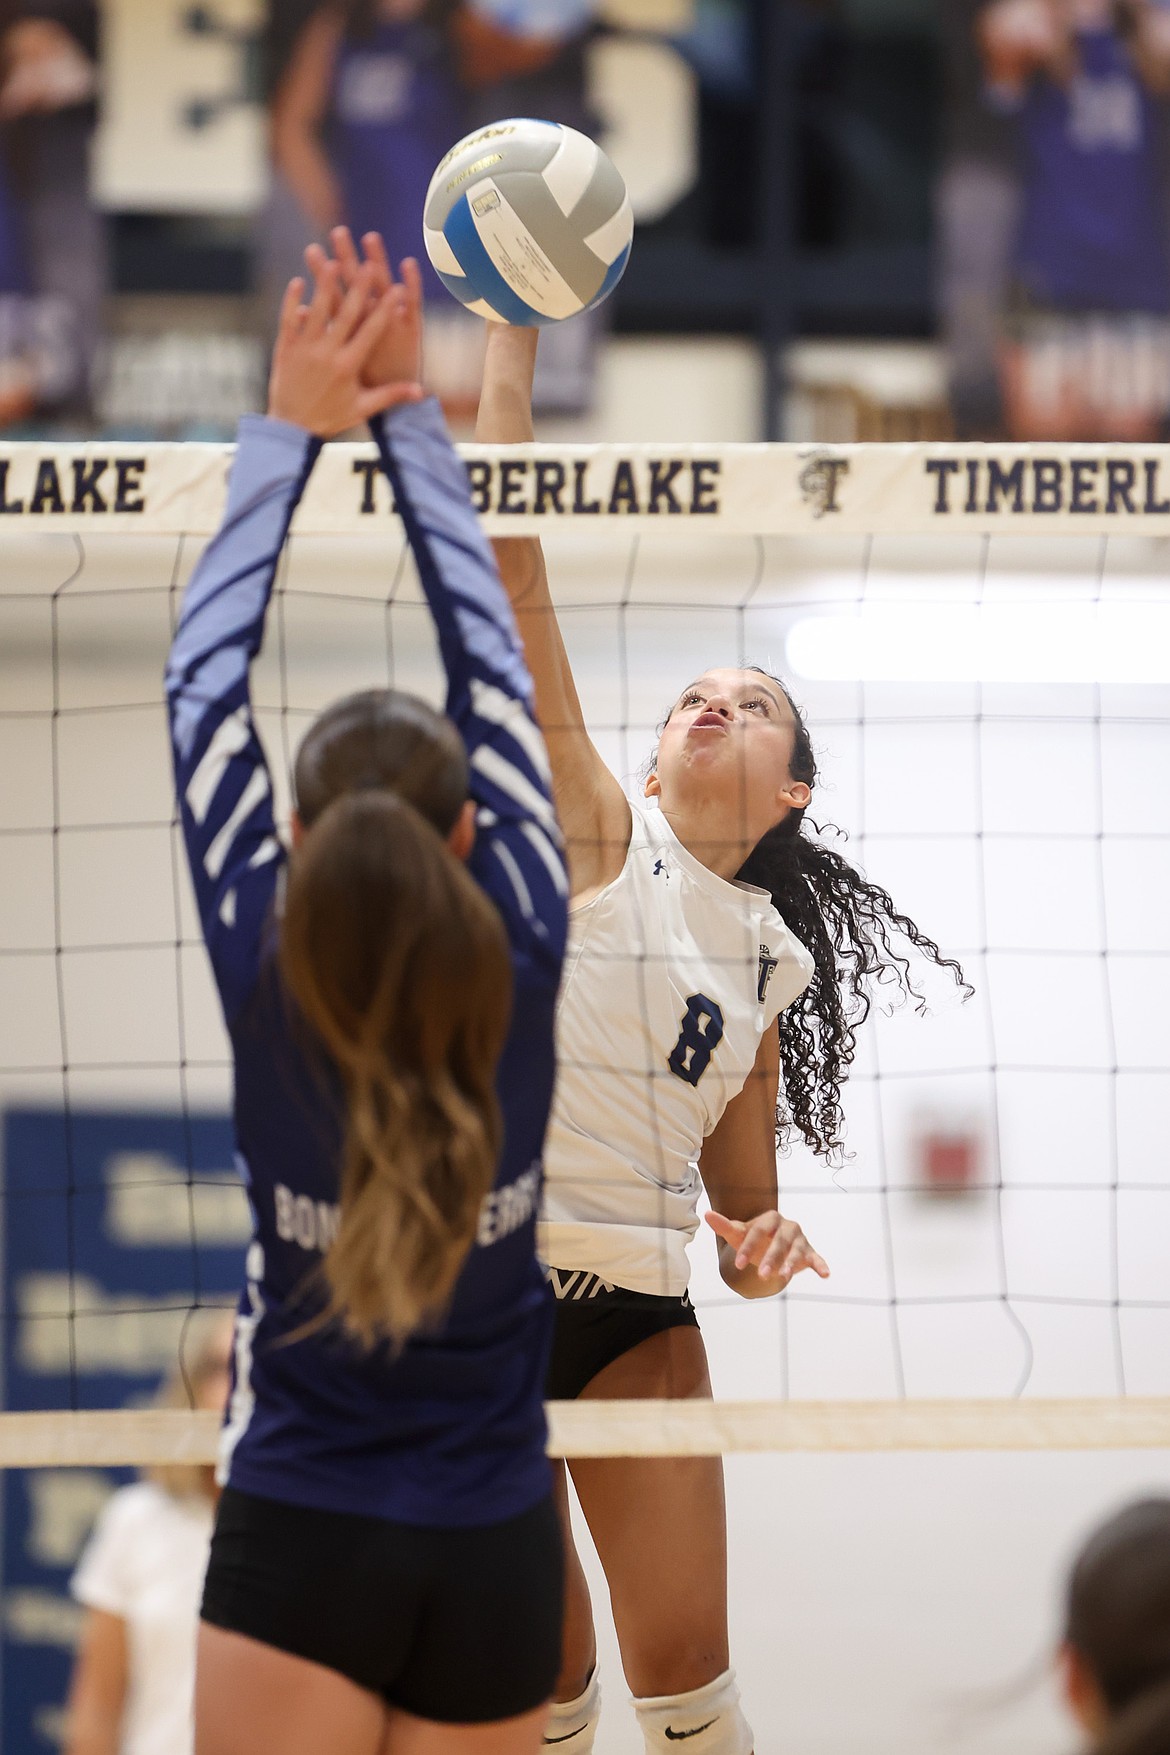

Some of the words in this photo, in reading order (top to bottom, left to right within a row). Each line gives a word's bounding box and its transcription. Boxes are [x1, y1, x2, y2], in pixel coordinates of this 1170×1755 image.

[0, 460, 146, 514] LAKE
[352, 460, 720, 514] TBERLAKE
[924, 459, 1170, 514] TIMBERL
[666, 992, 726, 1089] 8
